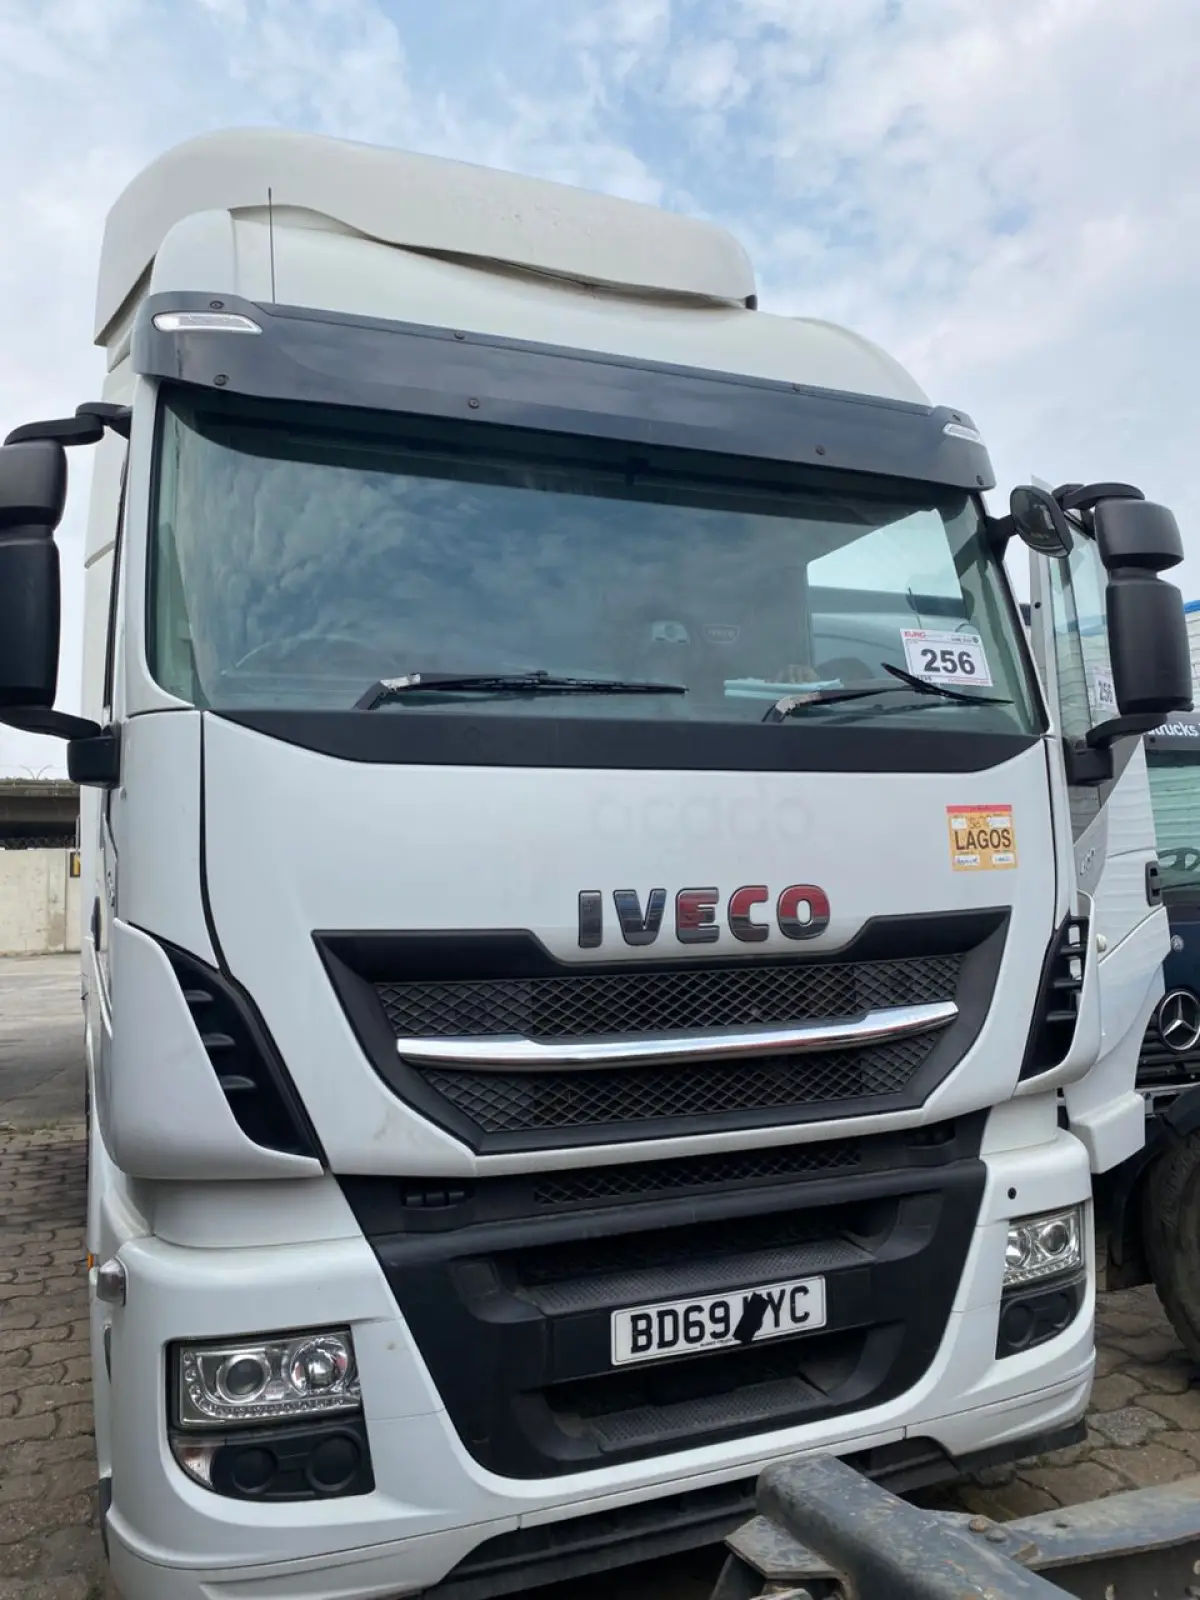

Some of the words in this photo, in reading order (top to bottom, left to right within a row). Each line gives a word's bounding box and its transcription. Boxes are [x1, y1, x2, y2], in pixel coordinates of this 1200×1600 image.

[920, 648, 976, 676] 256
[954, 828, 1012, 850] LAGOS
[578, 884, 831, 949] IVECO
[630, 1300, 731, 1354] BD69
[742, 1285, 810, 1336] YC
